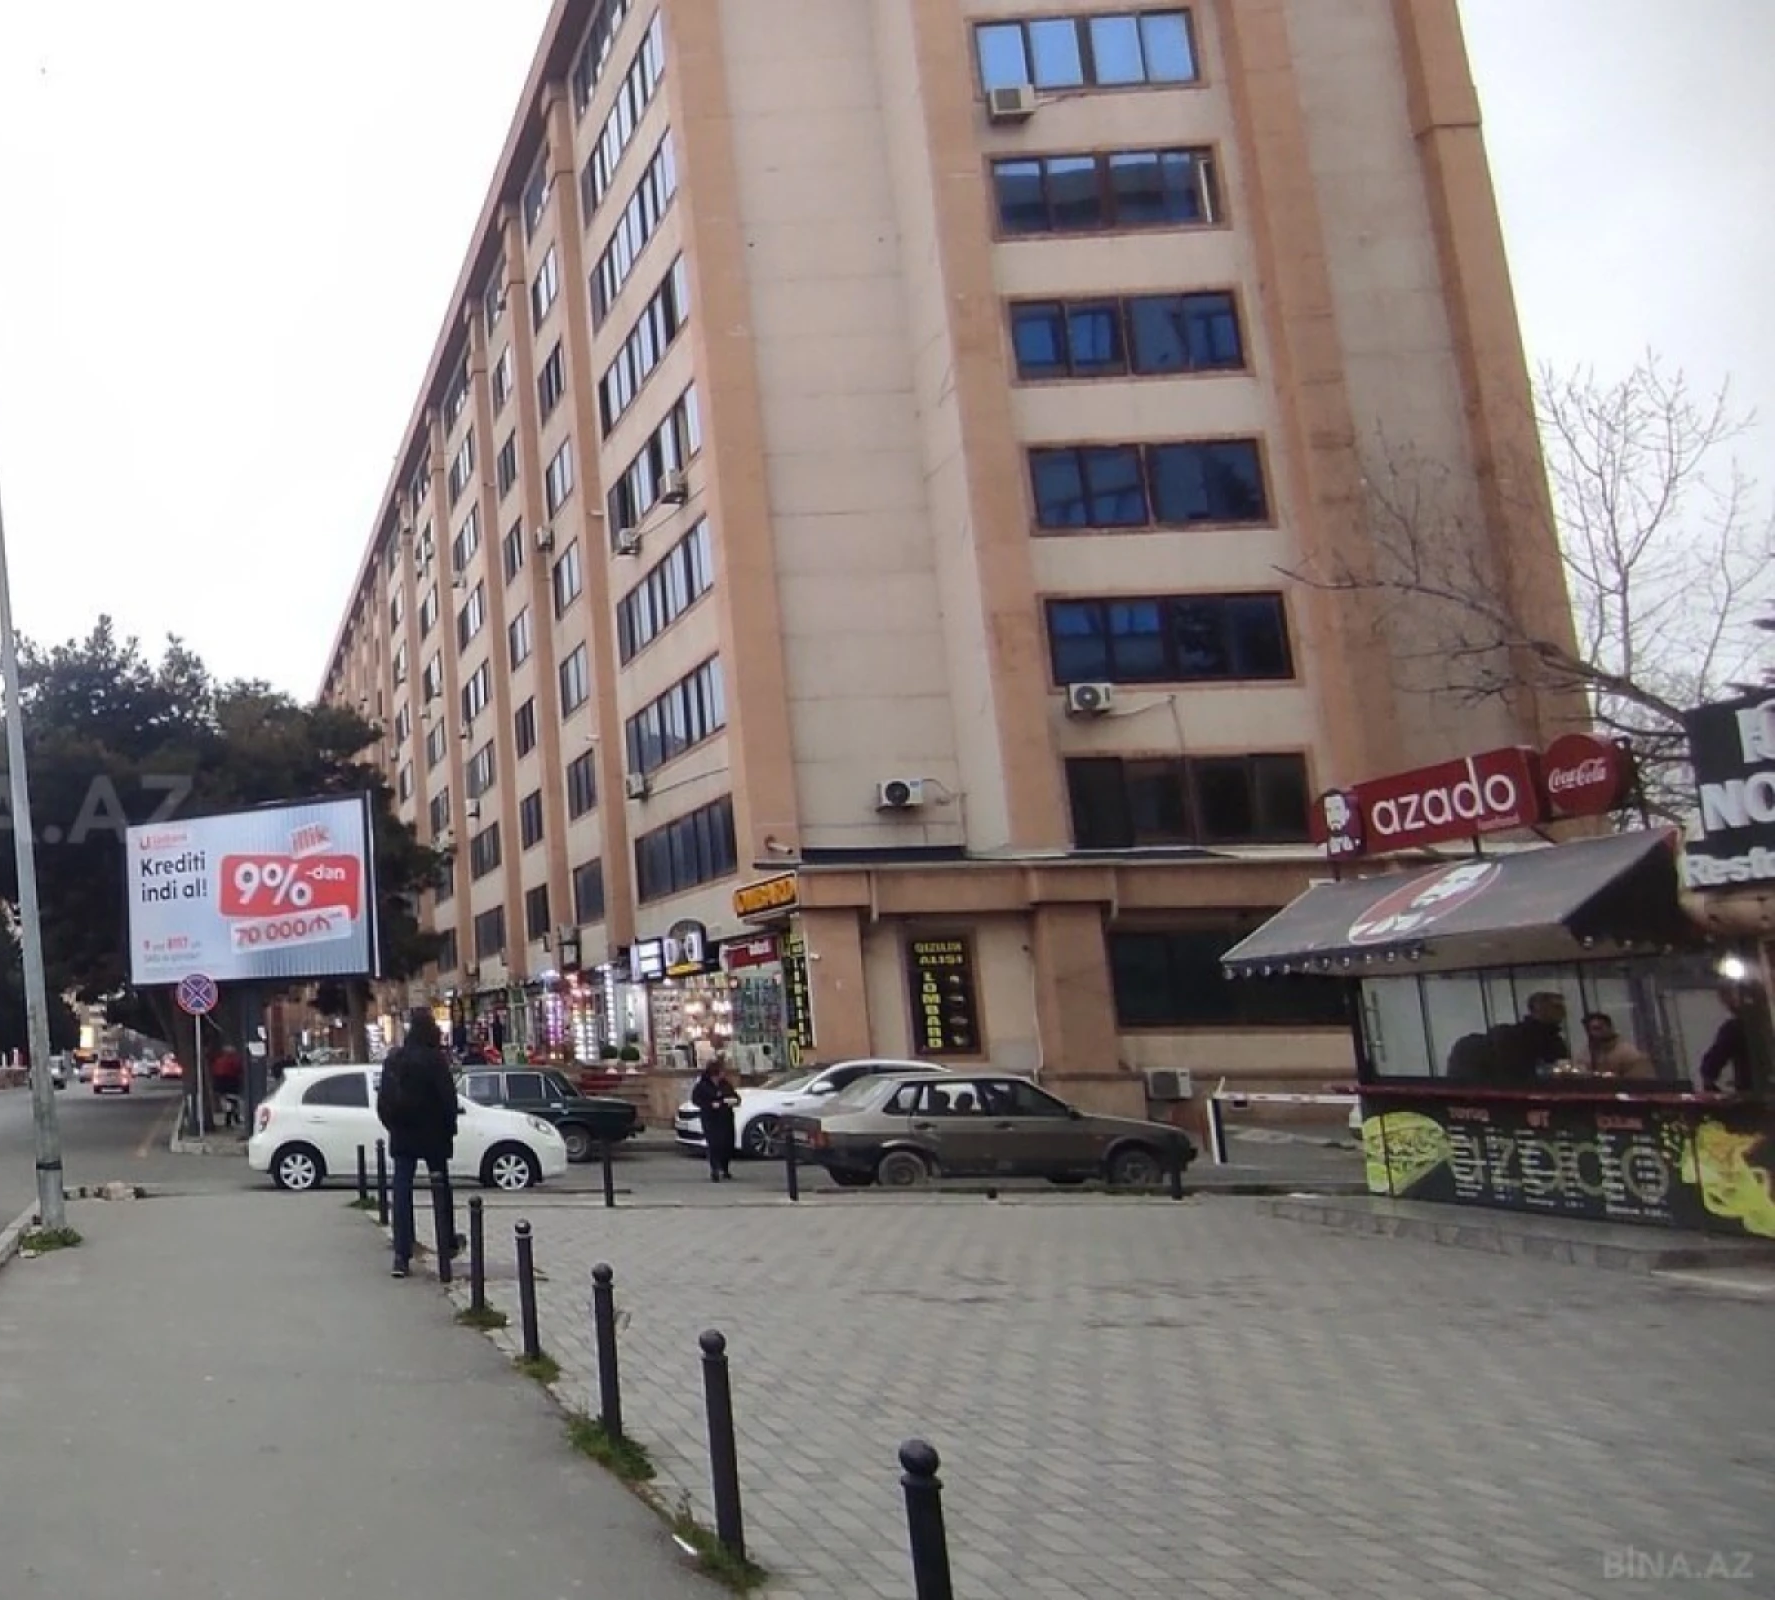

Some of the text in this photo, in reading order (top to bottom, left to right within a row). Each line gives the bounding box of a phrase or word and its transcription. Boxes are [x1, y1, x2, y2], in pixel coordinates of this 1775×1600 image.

[1548, 757, 1607, 793] Coca-Cola
[1371, 756, 1516, 835] azado
[141, 851, 206, 877] Krediti
[141, 879, 208, 902] indi al!
[235, 925, 260, 946] 70
[922, 971, 943, 1048] LOMBARD
